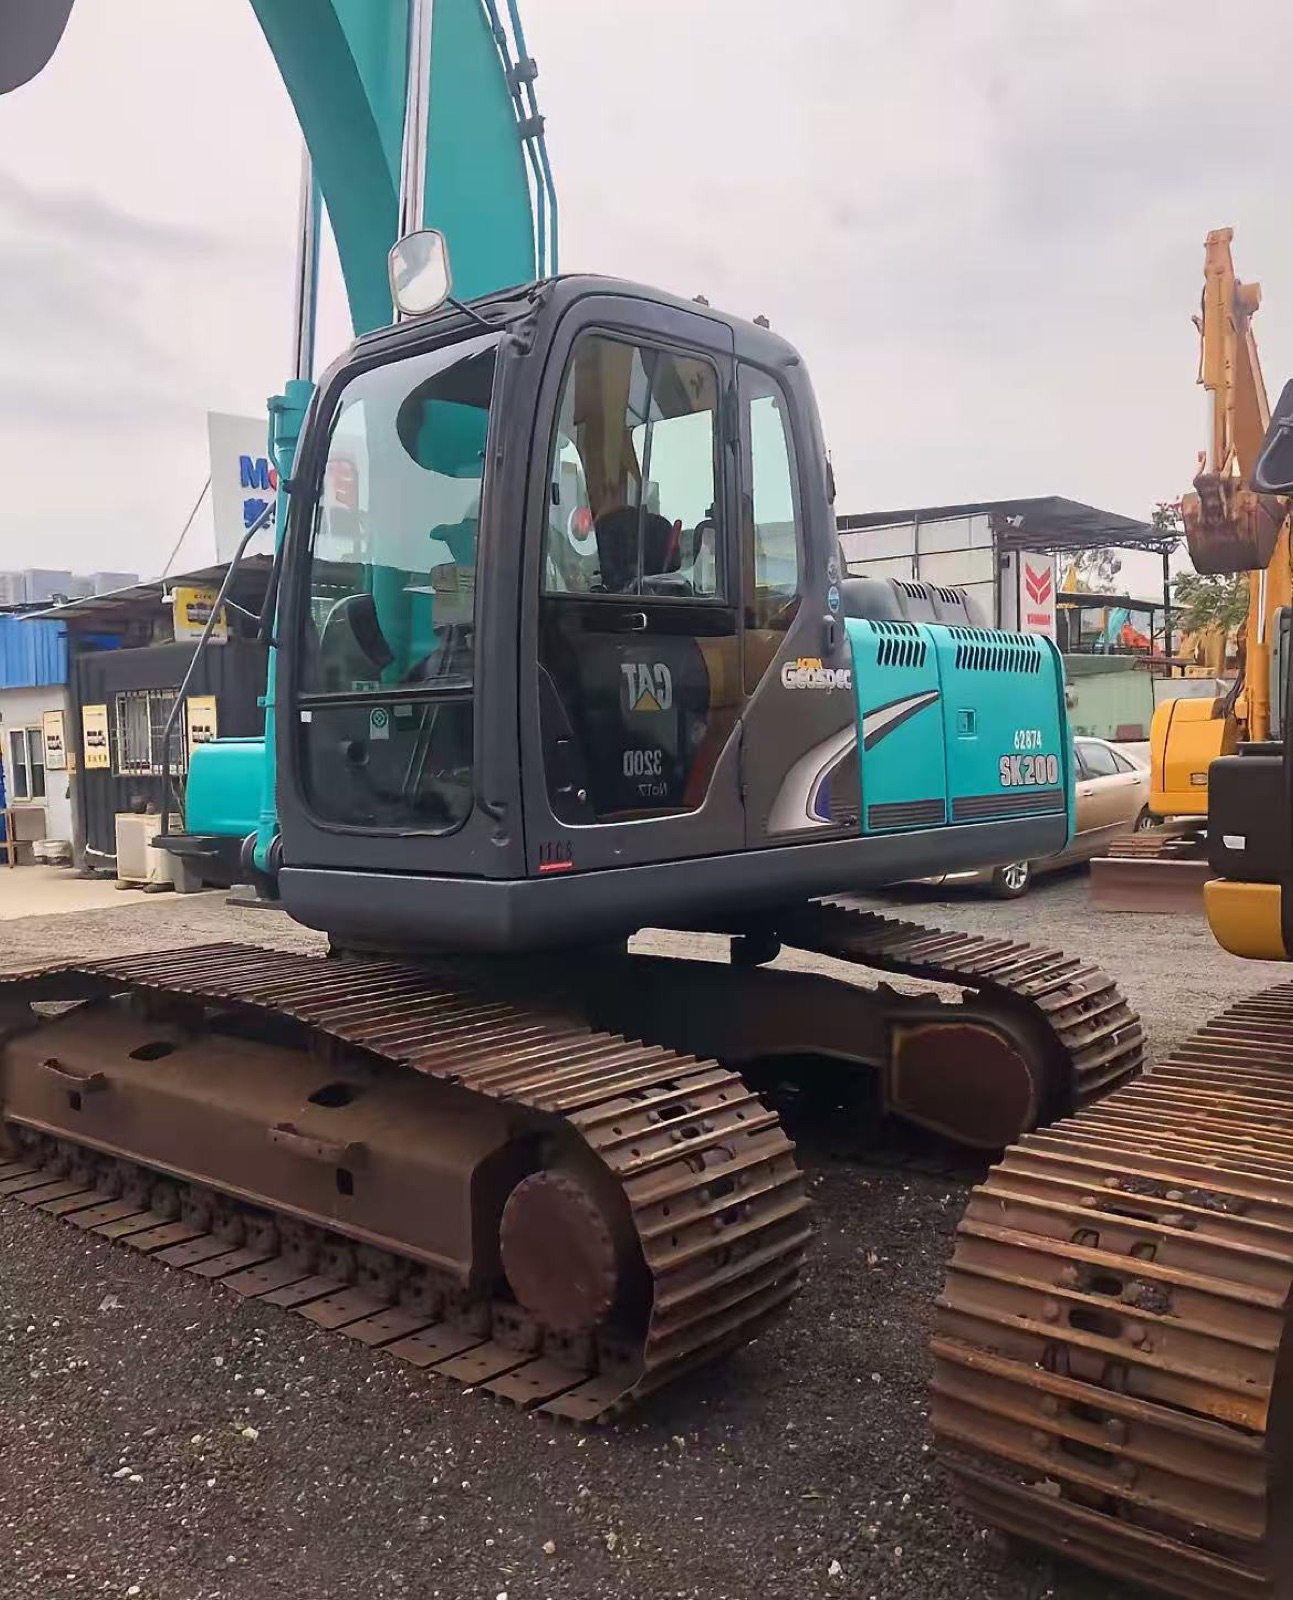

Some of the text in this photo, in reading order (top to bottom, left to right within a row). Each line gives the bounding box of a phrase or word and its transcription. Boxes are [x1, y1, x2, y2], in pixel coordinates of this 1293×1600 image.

[780, 661, 852, 694] Geospec
[1013, 730, 1042, 751] 62874
[999, 754, 1059, 787] SK200
